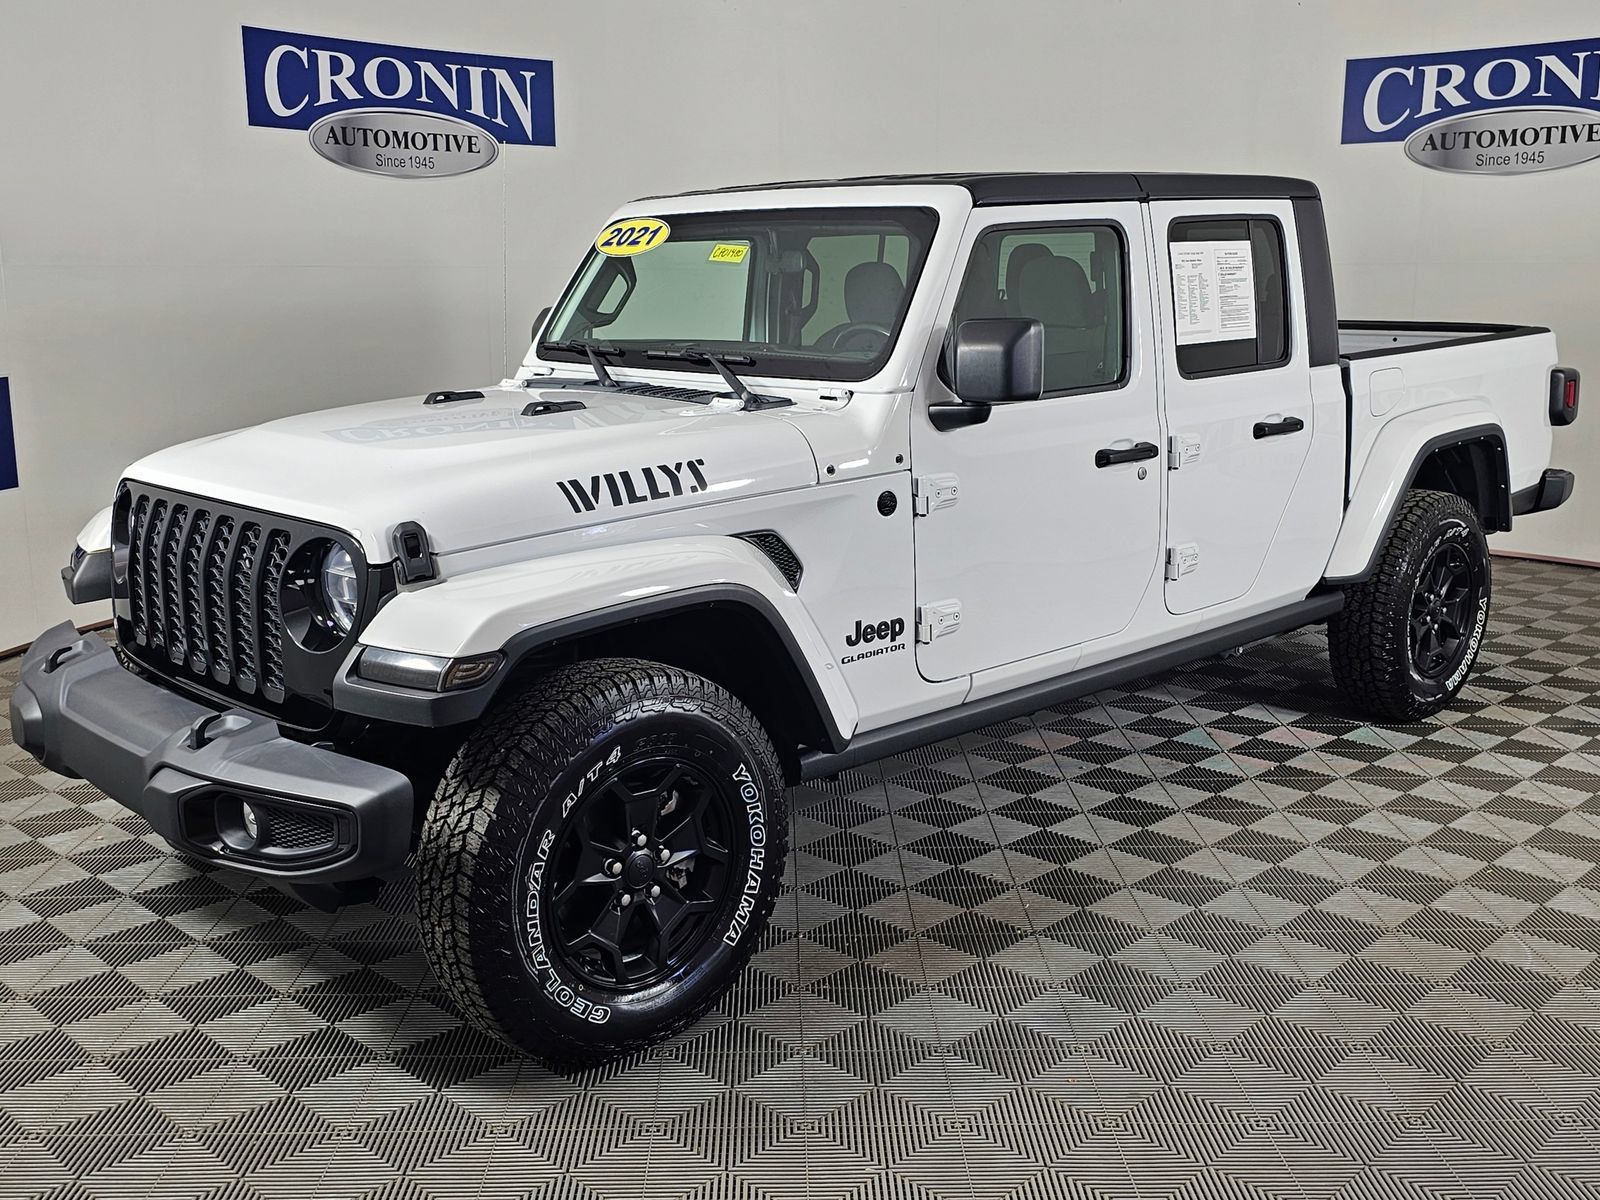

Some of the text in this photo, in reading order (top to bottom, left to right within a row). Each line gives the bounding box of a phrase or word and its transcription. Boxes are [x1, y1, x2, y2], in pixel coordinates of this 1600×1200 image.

[264, 44, 535, 142] CRONIN
[324, 125, 481, 154] AUTOMOTIVE
[1421, 123, 1600, 152] AUTOMOTIVE
[375, 153, 435, 170] Since 1945
[1475, 151, 1545, 167] Since 1945
[600, 225, 663, 248] 2021
[556, 458, 708, 513] WILLYS
[845, 617, 905, 647] Jeep
[1445, 597, 1488, 691] YOKOHAMA
[841, 643, 906, 665] GLADIATOR
[723, 763, 766, 946] YOKOHAMA
[526, 829, 611, 1024] GEOLANDAR
